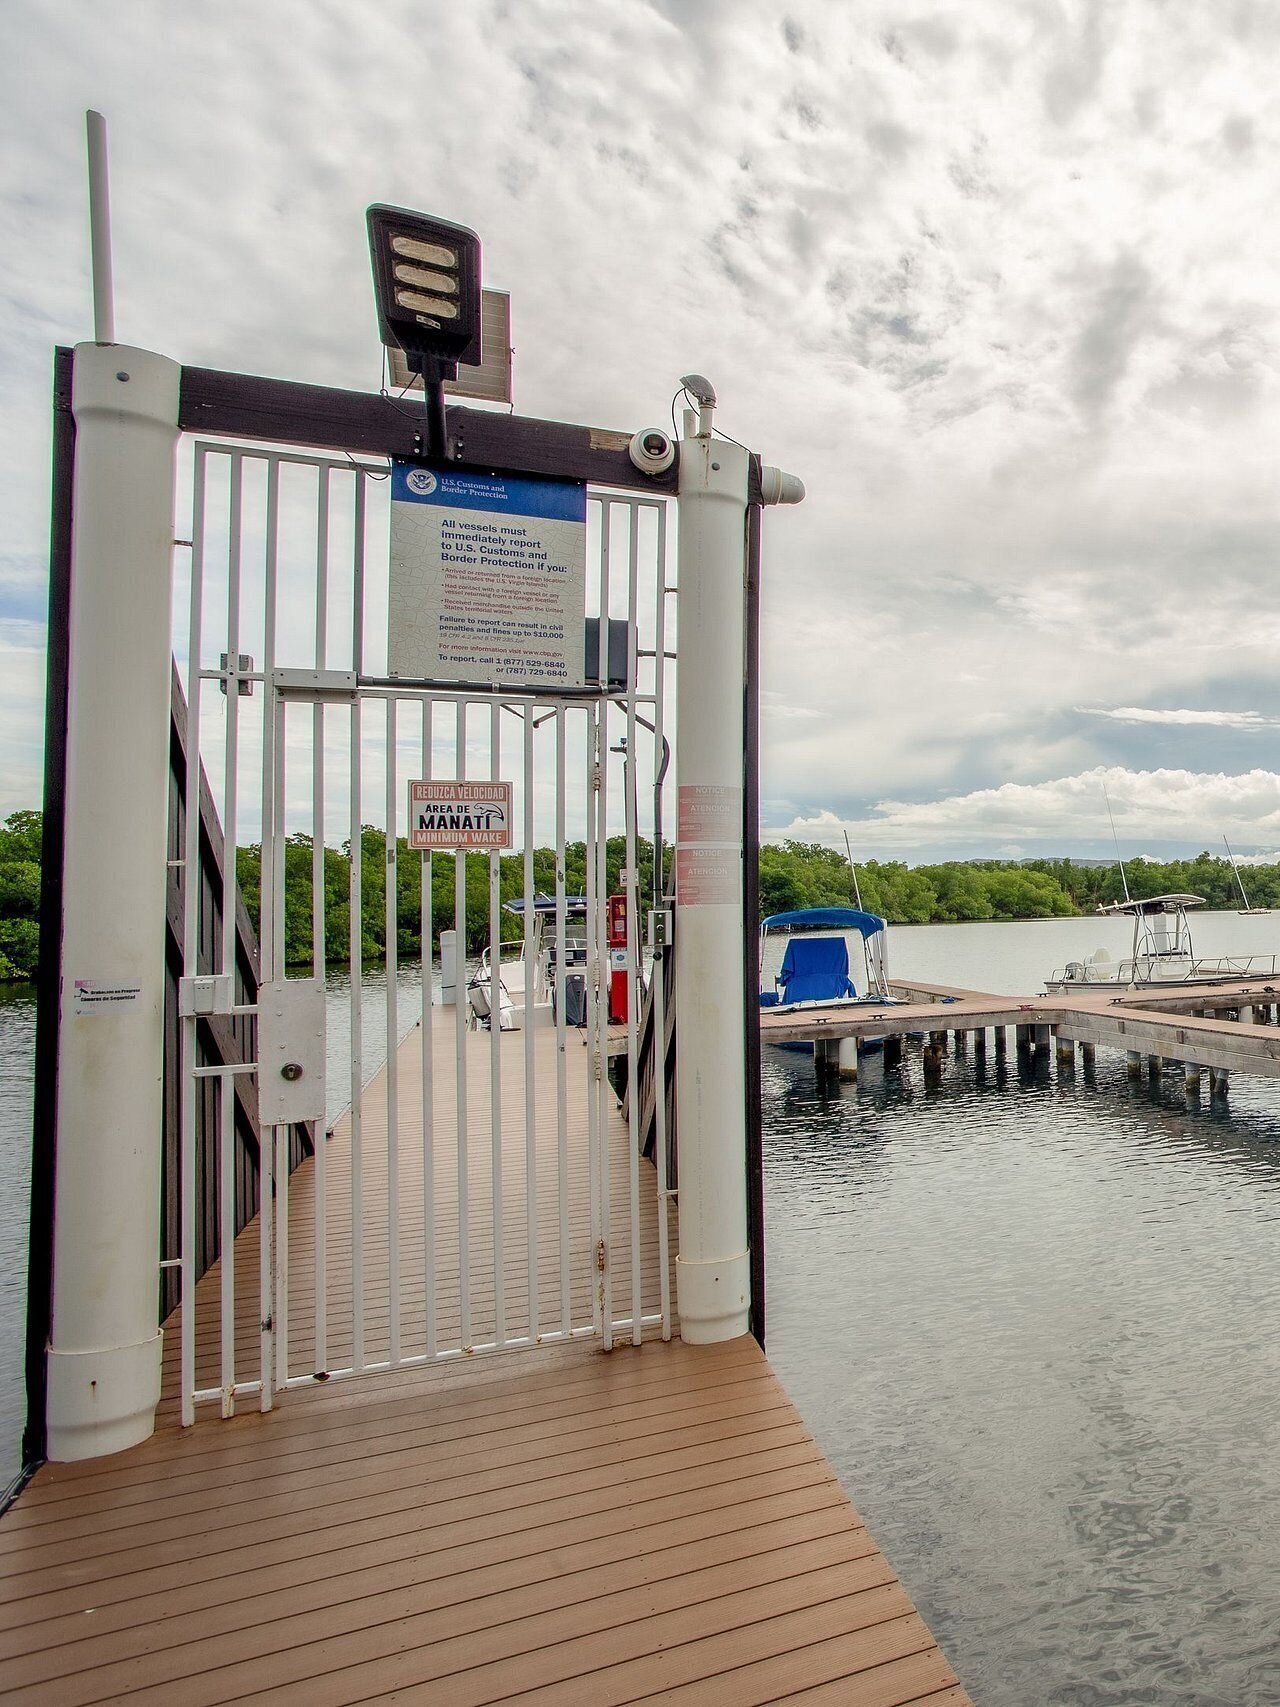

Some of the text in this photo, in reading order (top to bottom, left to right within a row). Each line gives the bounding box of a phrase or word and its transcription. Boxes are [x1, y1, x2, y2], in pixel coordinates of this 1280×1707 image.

[441, 478, 505, 493] U.S. Customs and
[441, 485, 508, 500] Border Protection
[441, 519, 527, 537] All vessels must
[441, 530, 541, 551] immediately report
[441, 542, 548, 561] to U.S. Customs and
[441, 552, 568, 574] Border Protection if you:
[444, 567, 466, 575] Arrived
[501, 572, 516, 580] from
[522, 574, 542, 584] foreign
[459, 584, 481, 592] contact
[501, 587, 521, 597] foreign
[464, 590, 491, 599] returning
[492, 592, 507, 600] from
[513, 594, 534, 604] foreign
[444, 598, 472, 607] Received
[473, 600, 511, 610] merchandise
[545, 606, 564, 614] United
[439, 615, 466, 624] Failure
[477, 619, 500, 628] report
[518, 622, 538, 630] result
[439, 624, 475, 633] penalties
[476, 626, 491, 634] and
[492, 627, 511, 635] fines
[533, 631, 564, 639] $10,000
[470, 645, 507, 654] information
[522, 648, 563, 658] www.cbp.gov
[479, 656, 494, 664] call
[503, 658, 525, 667] (877)
[525, 659, 566, 668] 529-6840
[505, 667, 527, 676] (787)
[528, 668, 568, 677] 729-6840
[416, 786, 504, 800] REDUZCA VELOCIDAD
[695, 787, 725, 795] NOTICE
[425, 803, 470, 813] ÁREA DE
[416, 832, 502, 843] MINIMUM WAKE
